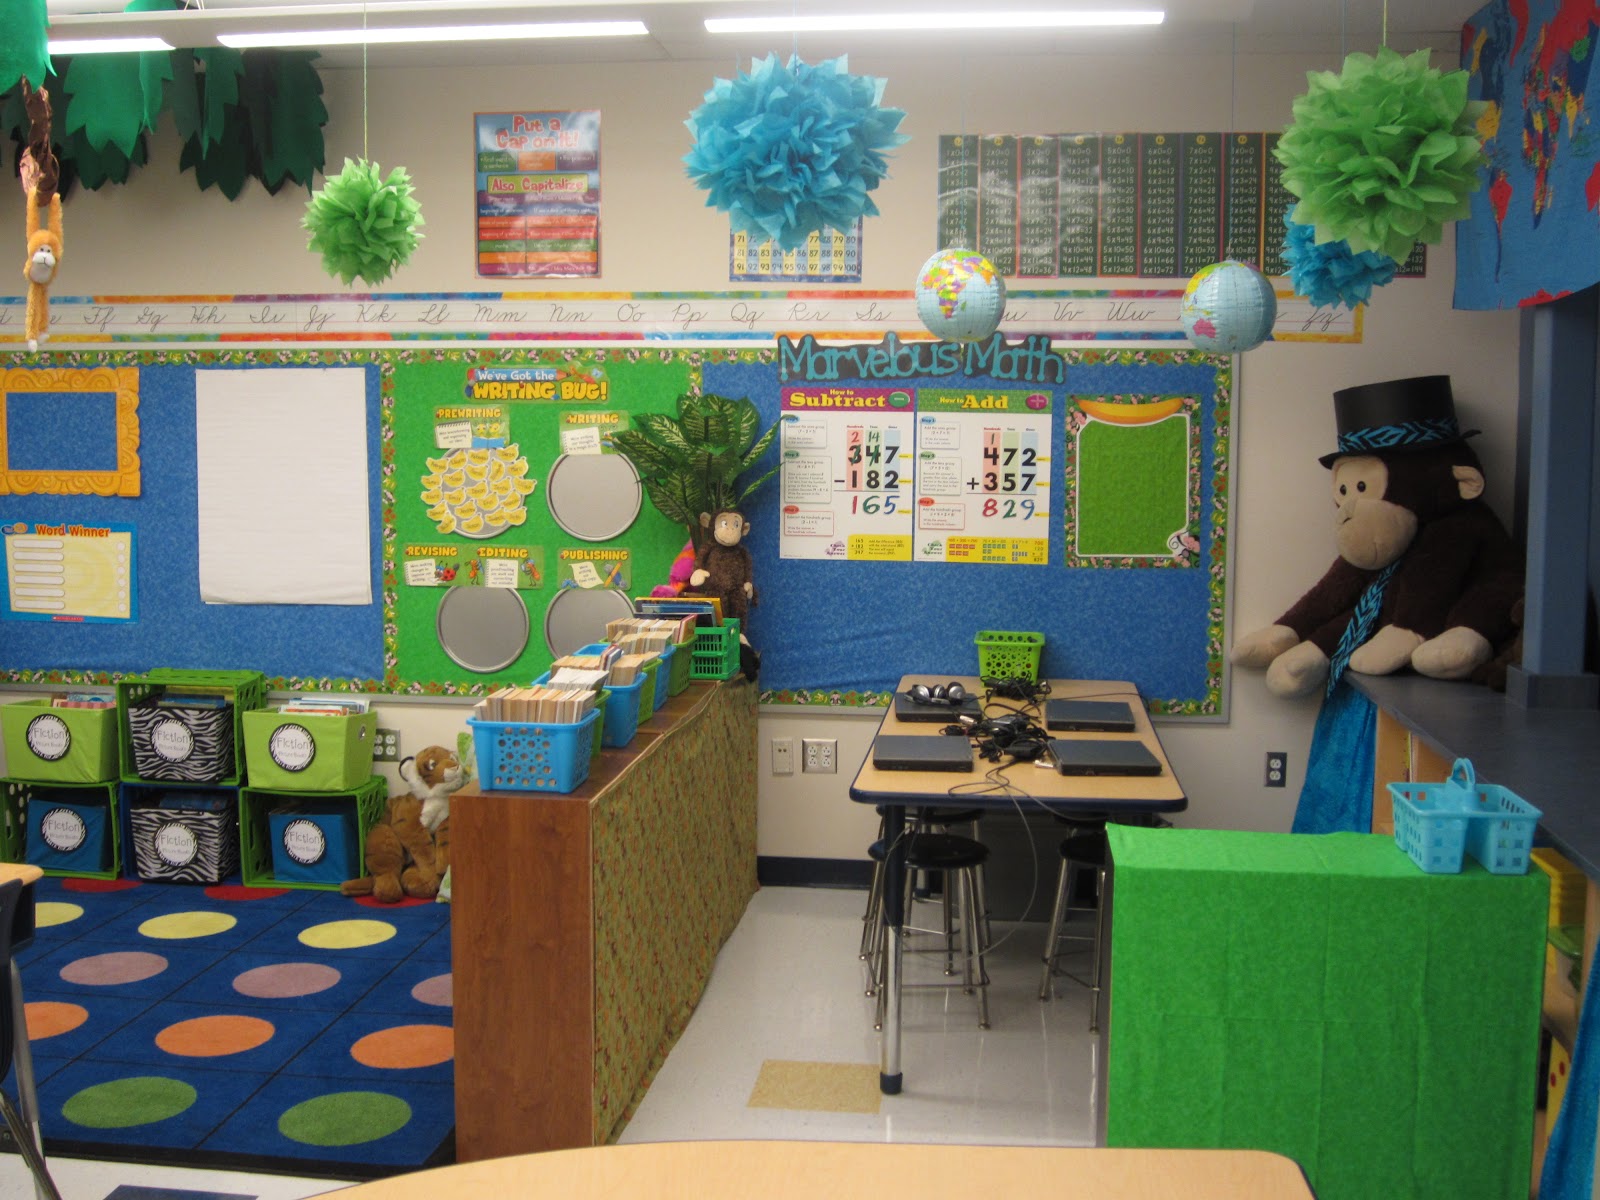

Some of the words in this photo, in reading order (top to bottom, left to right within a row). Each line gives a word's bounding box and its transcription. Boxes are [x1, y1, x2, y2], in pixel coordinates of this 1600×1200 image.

[513, 115, 543, 133] Put
[550, 119, 561, 131] a
[496, 129, 528, 149] Cap
[532, 136, 555, 149] on
[492, 179, 515, 192] Also
[522, 178, 584, 192] Capitalize
[737, 263, 745, 271] 91
[760, 263, 770, 271] 93
[784, 263, 794, 271] 95
[809, 263, 818, 271] 97
[821, 263, 831, 271] 98
[833, 263, 843, 271] 99
[357, 304, 397, 323] Kk
[473, 303, 527, 322] Mm
[550, 303, 593, 322] Nn
[617, 303, 646, 322] Oo
[672, 303, 708, 330] Pp
[730, 303, 765, 329] Qq
[789, 302, 830, 321] Rr
[856, 302, 892, 321] Ss
[1053, 302, 1084, 321] Vv
[1107, 302, 1155, 321] Ww
[779, 332, 960, 380] Marvelous
[964, 332, 1064, 383] Math
[478, 369, 507, 380] We've
[510, 370, 532, 381] Got
[536, 370, 555, 381] the
[474, 382, 556, 400] WRITING
[561, 382, 608, 400] BUG!
[789, 392, 886, 408] Subtract
[962, 395, 1009, 409] Add
[439, 409, 502, 419] PREWRITING
[568, 414, 619, 424] WRITING
[851, 431, 860, 443] 2
[868, 431, 880, 443] 14
[984, 447, 1036, 467] 472
[852, 495, 900, 515] 165
[982, 498, 1035, 520] 829
[36, 524, 66, 536] Word
[69, 525, 111, 538] Winner
[407, 546, 458, 557] REVISING
[478, 548, 529, 559] EDITING
[562, 550, 629, 561] PUBLISHING
[34, 728, 65, 740] Fiction
[157, 730, 189, 744] Fiction
[277, 737, 309, 750] Fiction
[48, 820, 80, 832] Fiction
[160, 834, 192, 847] Fiction
[290, 831, 320, 844] Fiction
